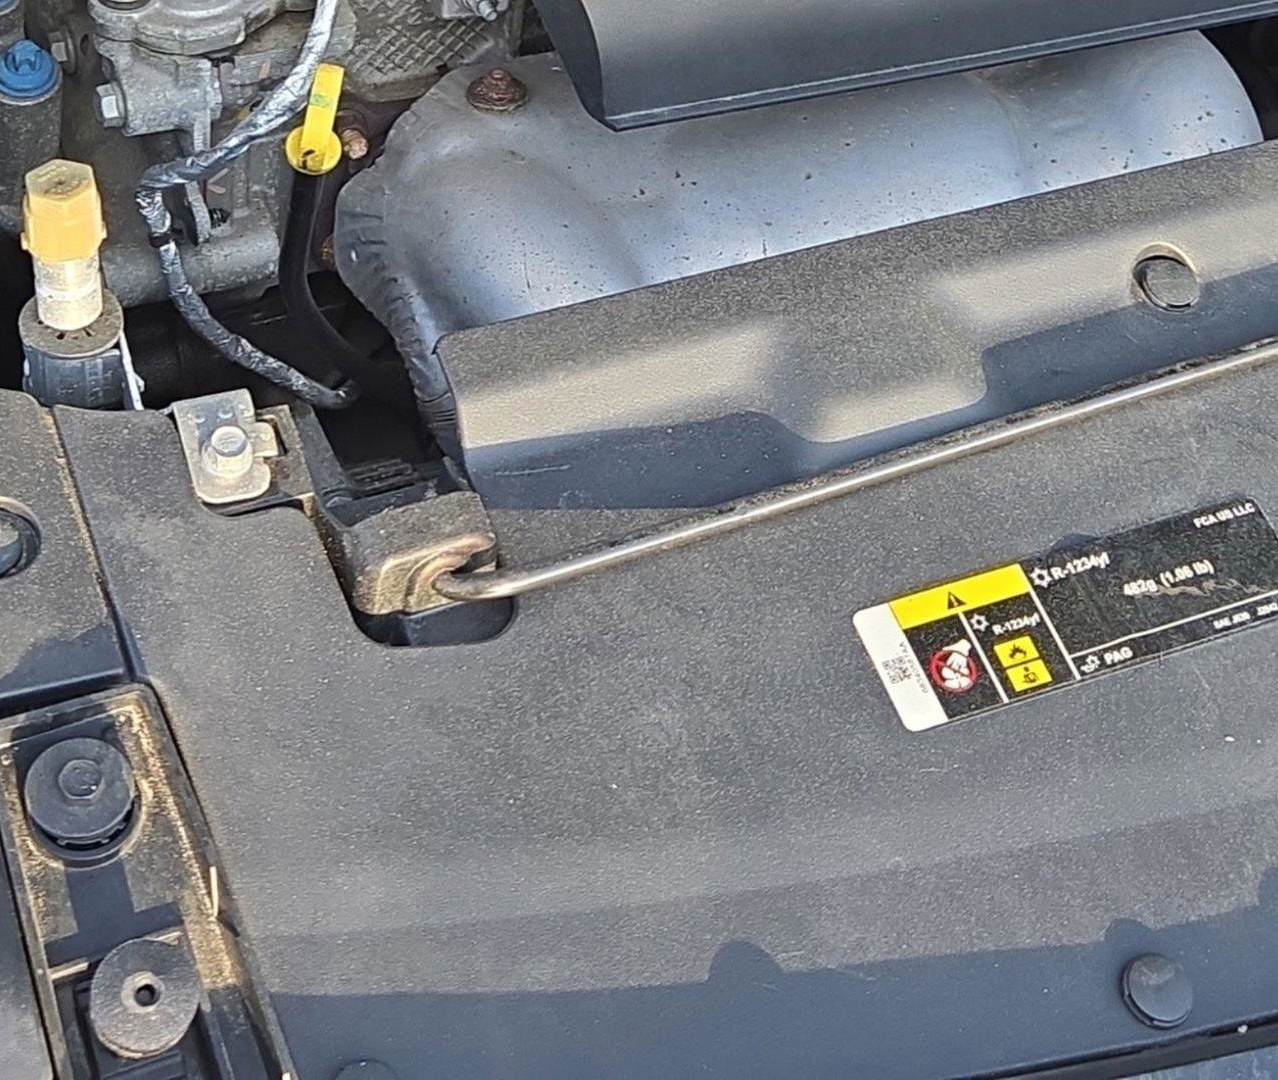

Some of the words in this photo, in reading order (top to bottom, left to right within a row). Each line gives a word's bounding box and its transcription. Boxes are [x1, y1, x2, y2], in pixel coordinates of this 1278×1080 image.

[1193, 515, 1219, 528] FCA
[1233, 502, 1256, 517] LLC
[1050, 552, 1111, 582] R-1234yf
[1194, 558, 1215, 581] lb)
[1103, 644, 1133, 667] PAG
